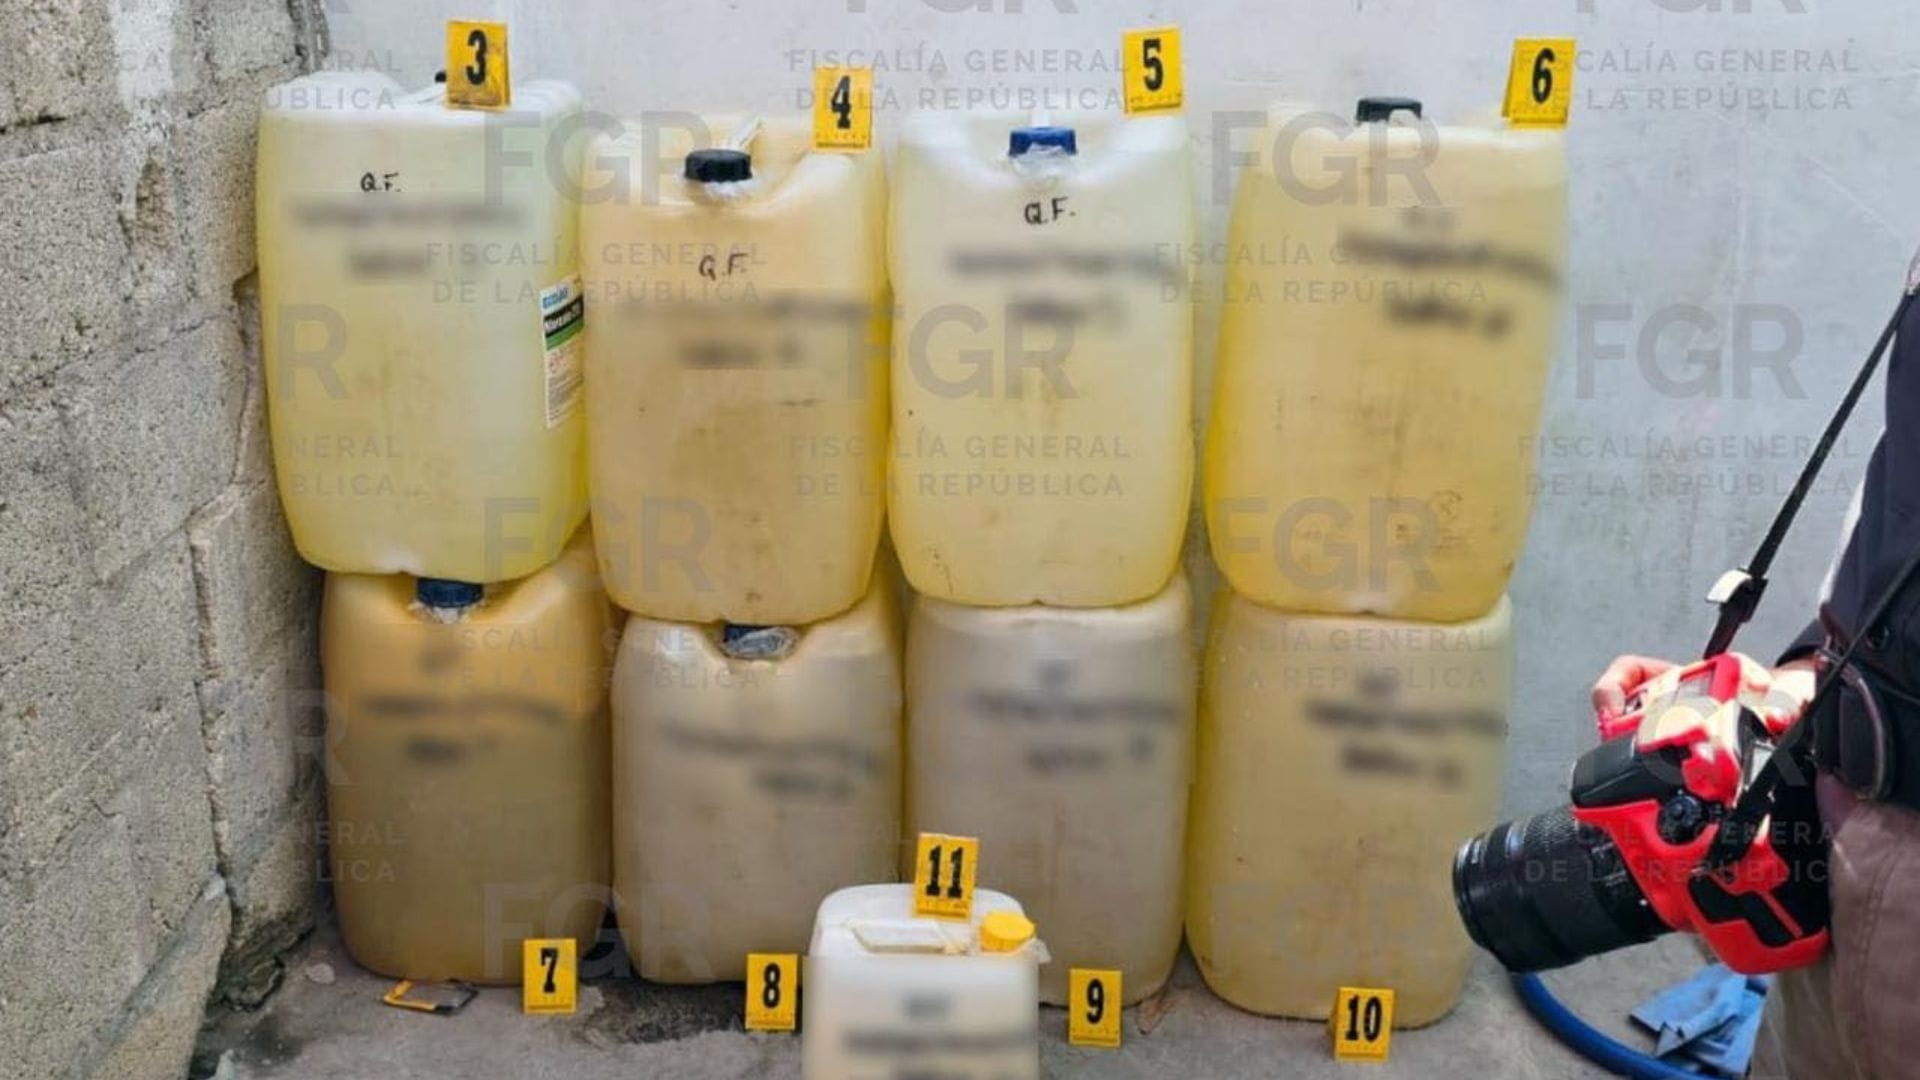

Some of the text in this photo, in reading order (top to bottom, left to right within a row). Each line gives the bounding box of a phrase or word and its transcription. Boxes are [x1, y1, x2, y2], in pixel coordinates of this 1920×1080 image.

[465, 29, 487, 86] 3
[1142, 38, 1163, 92] 5
[1532, 48, 1555, 104] 6
[831, 75, 851, 130] 4
[926, 844, 963, 898] 11
[540, 947, 558, 993] 7
[763, 962, 780, 1008] 8
[1086, 979, 1104, 1024] 9
[1345, 994, 1382, 1042] 10
